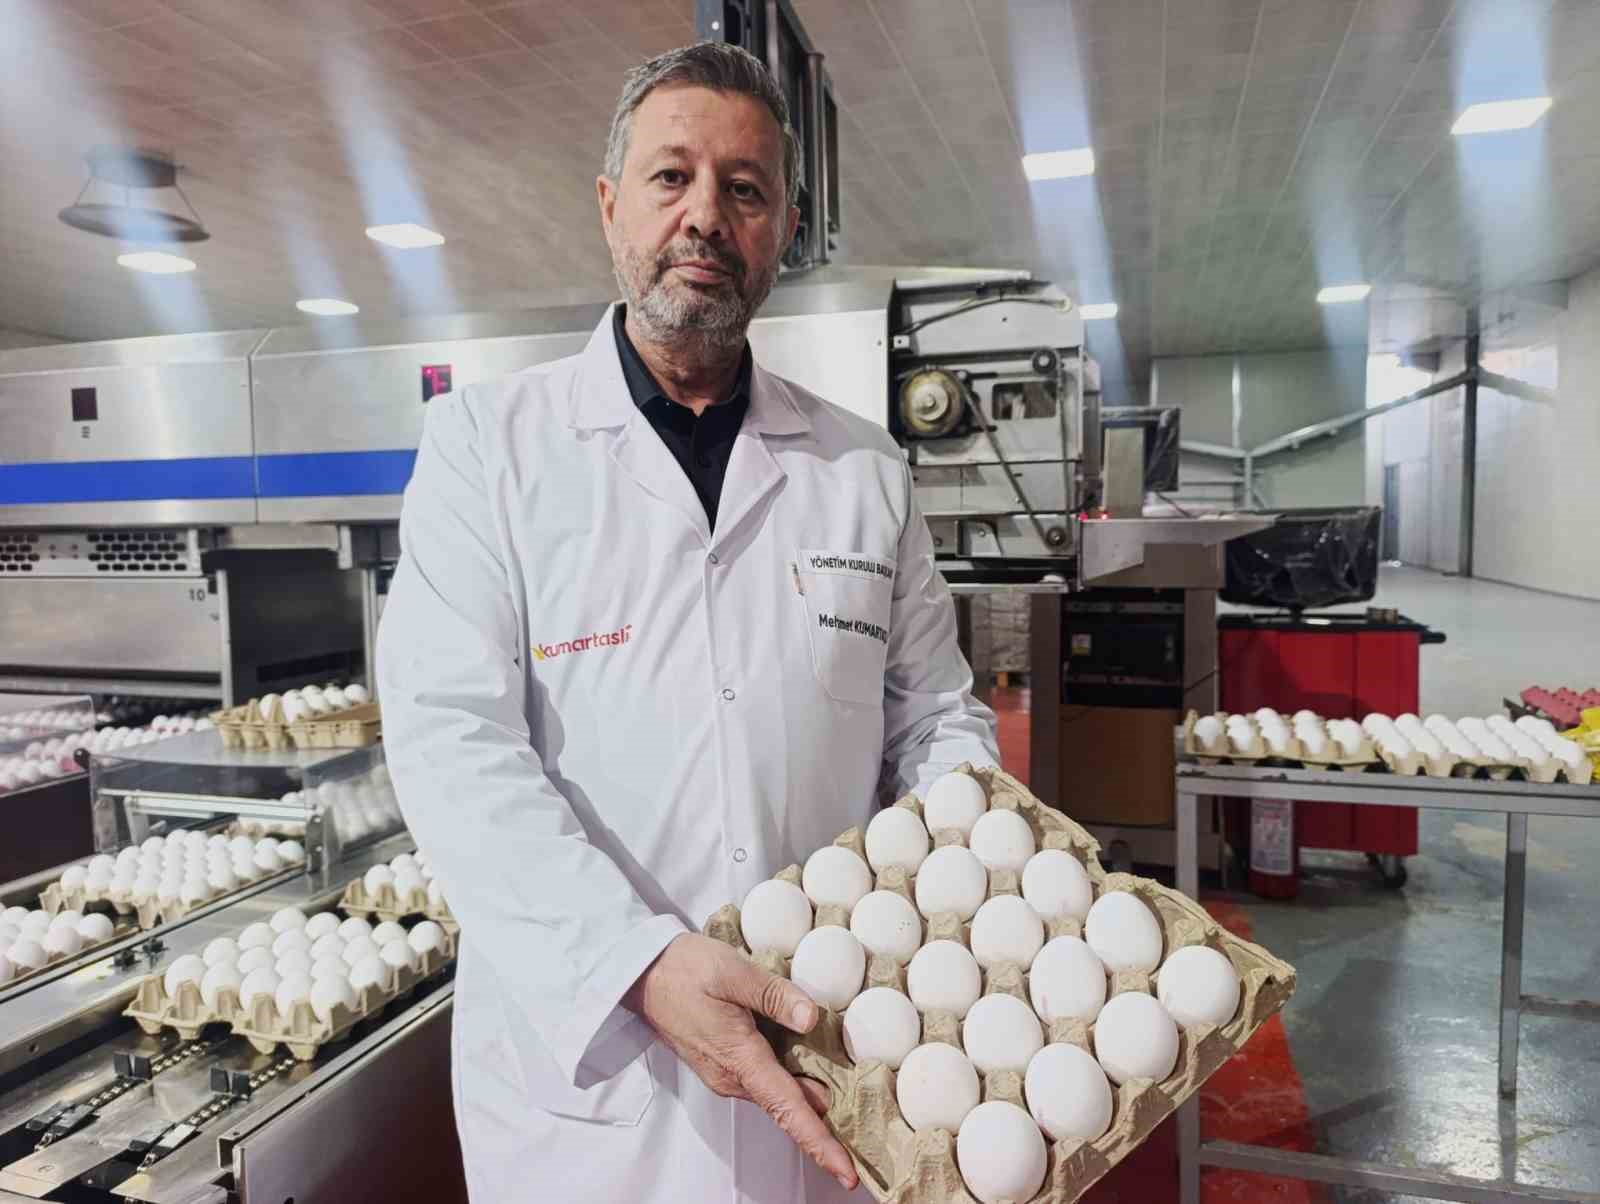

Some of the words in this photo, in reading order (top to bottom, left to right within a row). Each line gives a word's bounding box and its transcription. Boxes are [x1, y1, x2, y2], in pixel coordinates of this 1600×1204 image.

[809, 555, 847, 569] YÖNETİM
[848, 559, 876, 574] KURULU
[818, 613, 853, 632] Mehmet
